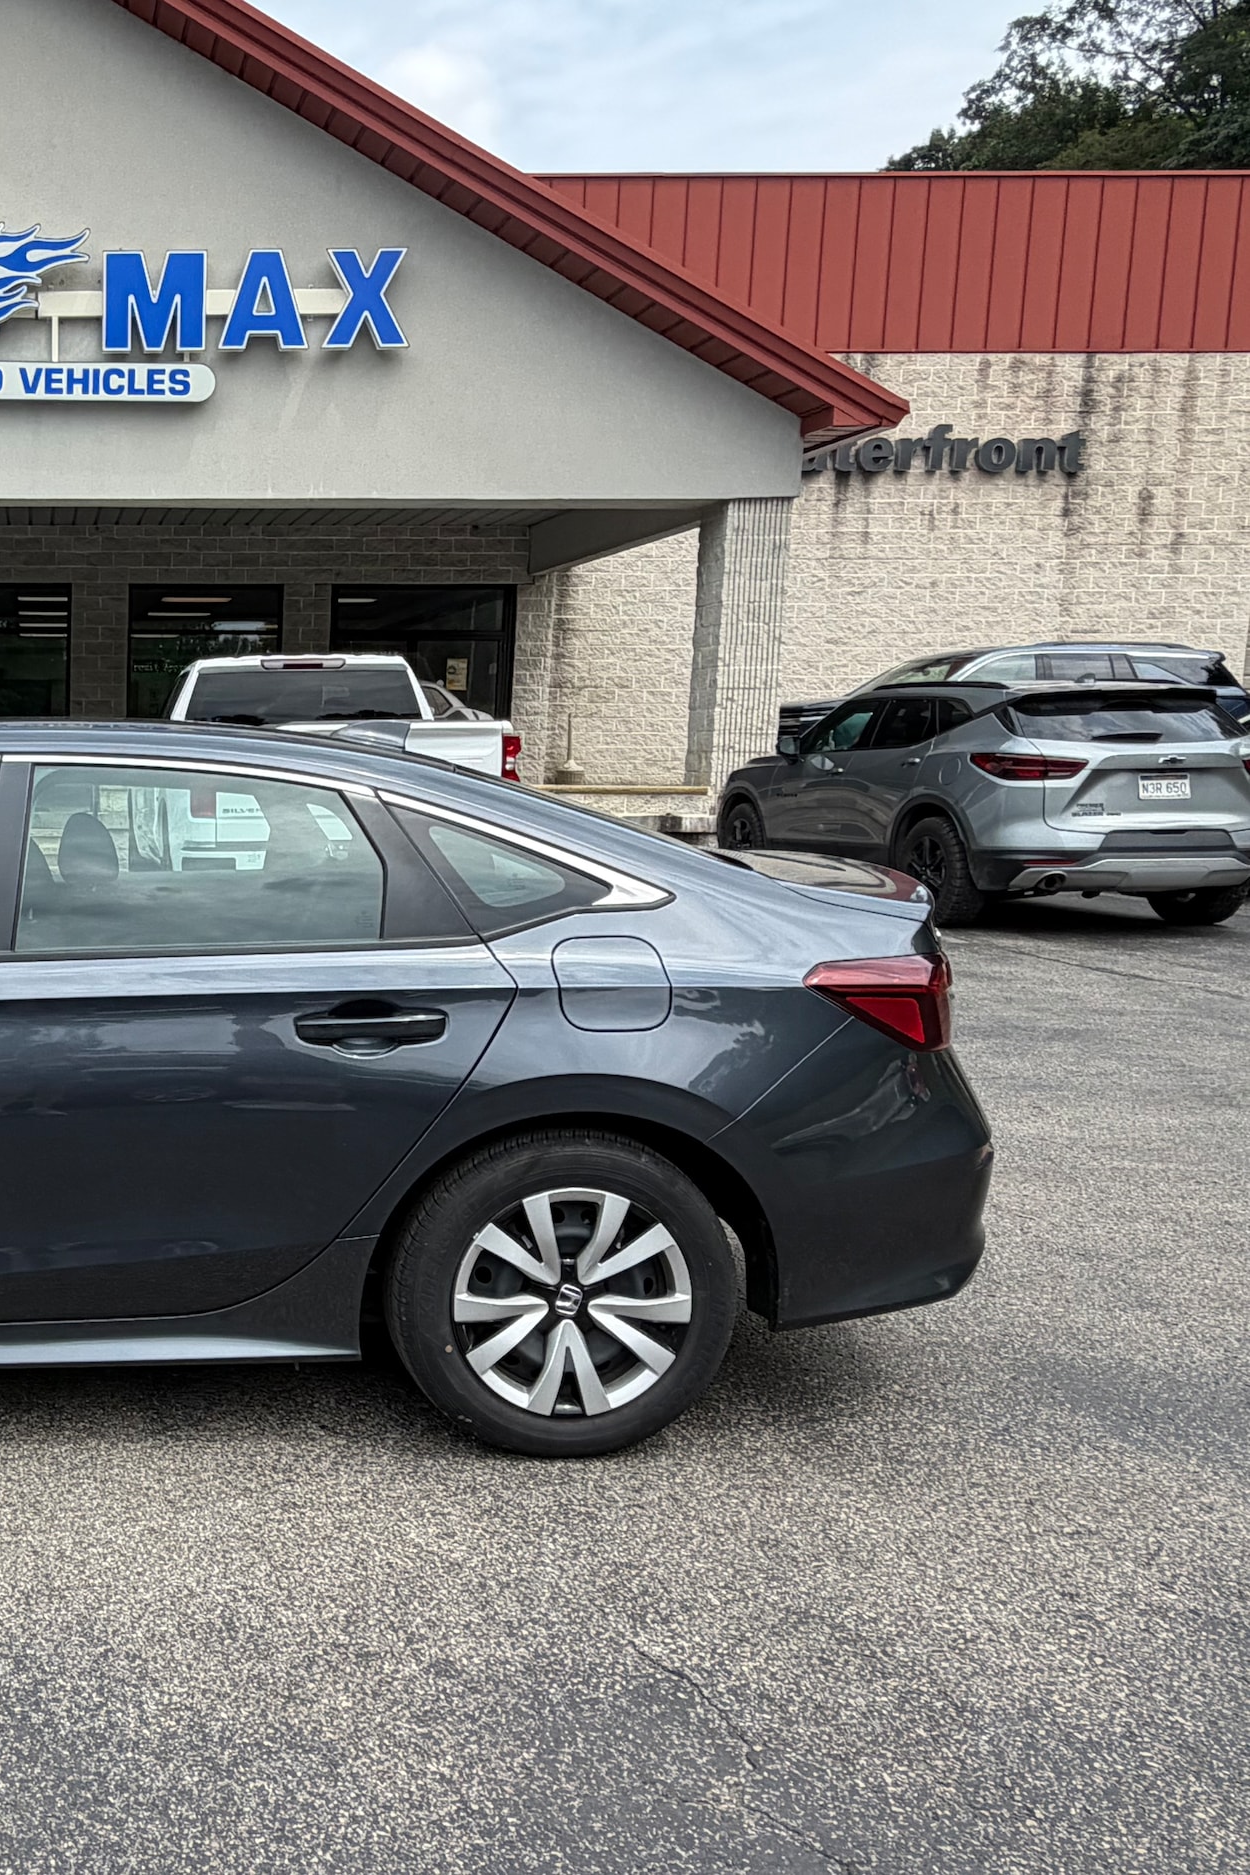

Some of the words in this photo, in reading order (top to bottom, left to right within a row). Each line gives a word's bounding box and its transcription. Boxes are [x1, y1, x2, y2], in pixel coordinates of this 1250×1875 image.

[102, 247, 409, 353] MAX
[19, 367, 191, 396] VEHICLES
[801, 424, 1086, 474] aterfront
[1142, 782, 1163, 794] N3R
